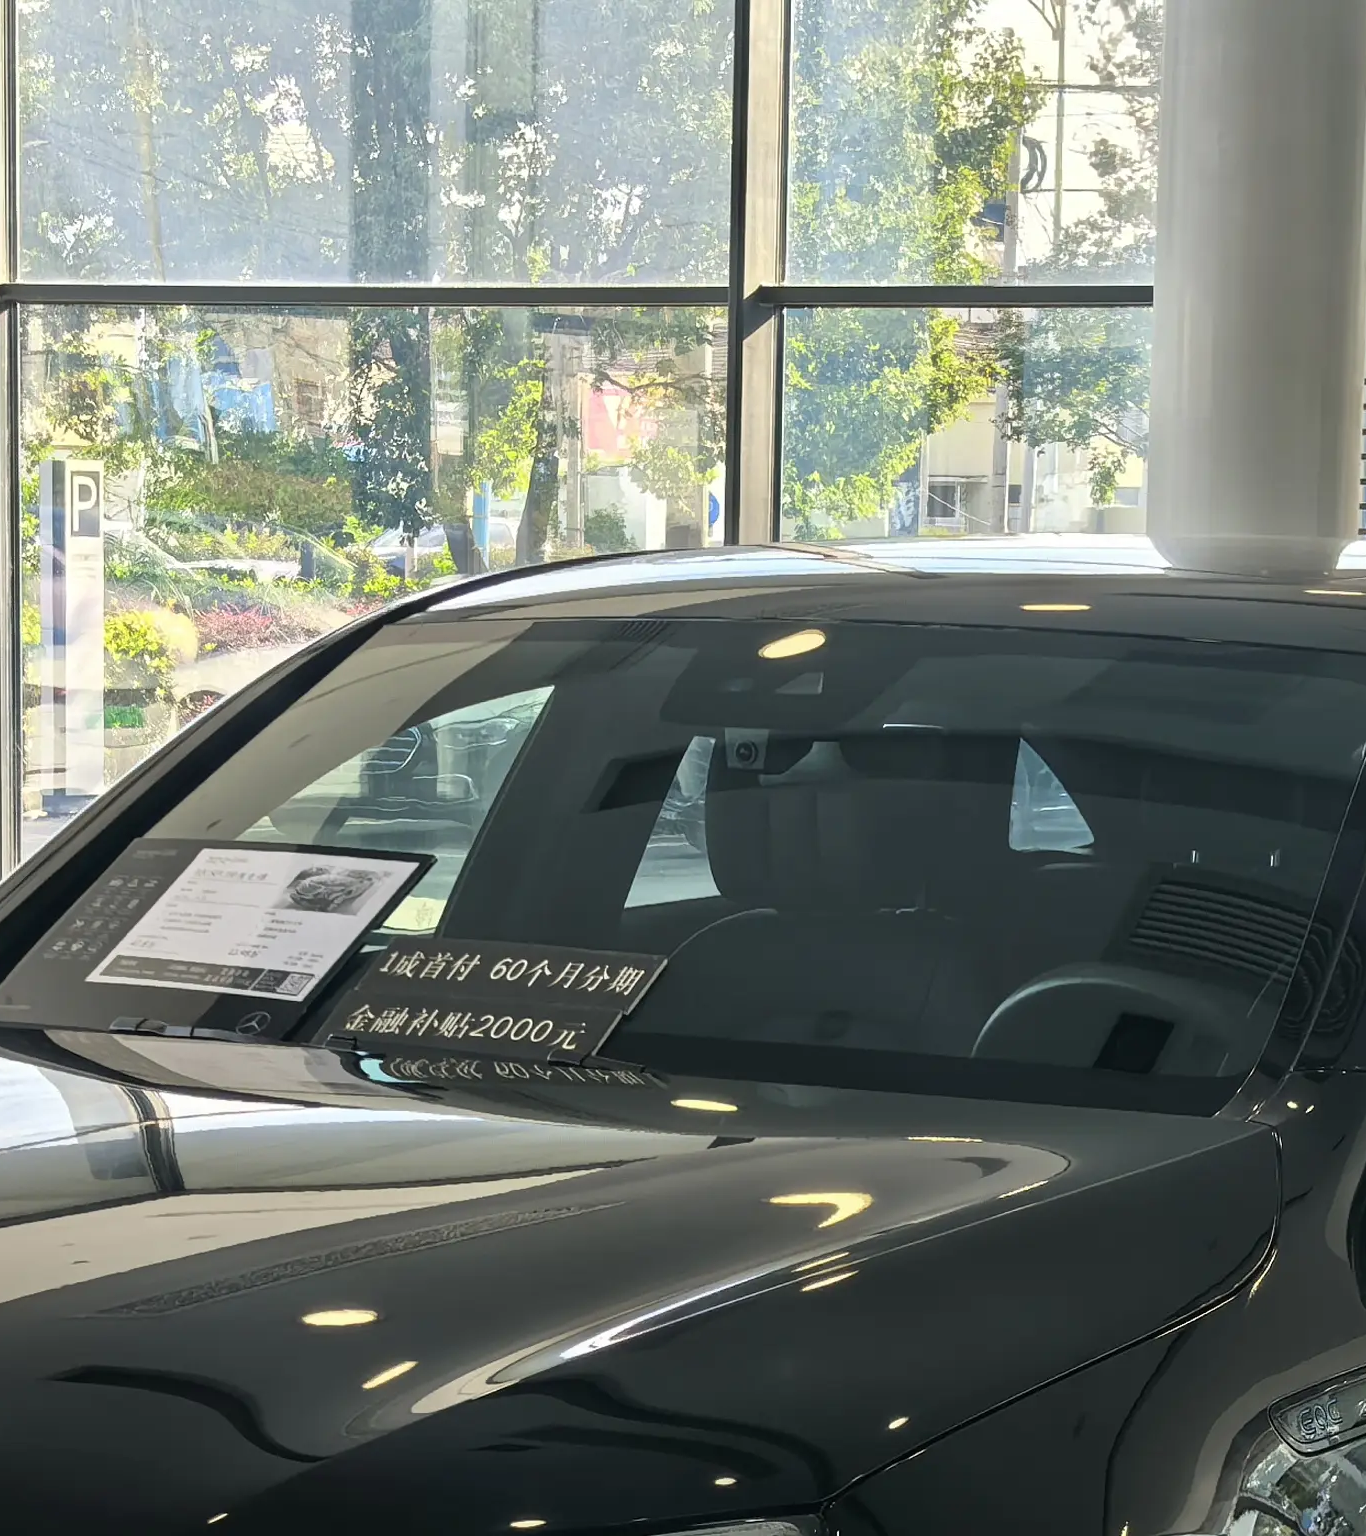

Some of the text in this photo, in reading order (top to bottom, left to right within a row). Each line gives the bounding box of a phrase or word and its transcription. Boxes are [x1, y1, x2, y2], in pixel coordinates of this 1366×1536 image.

[73, 475, 97, 532] P
[380, 951, 645, 996] 1成首付 60个月分期
[344, 1004, 587, 1050] 金融补贴2000元
[1298, 1398, 1343, 1436] EQC
